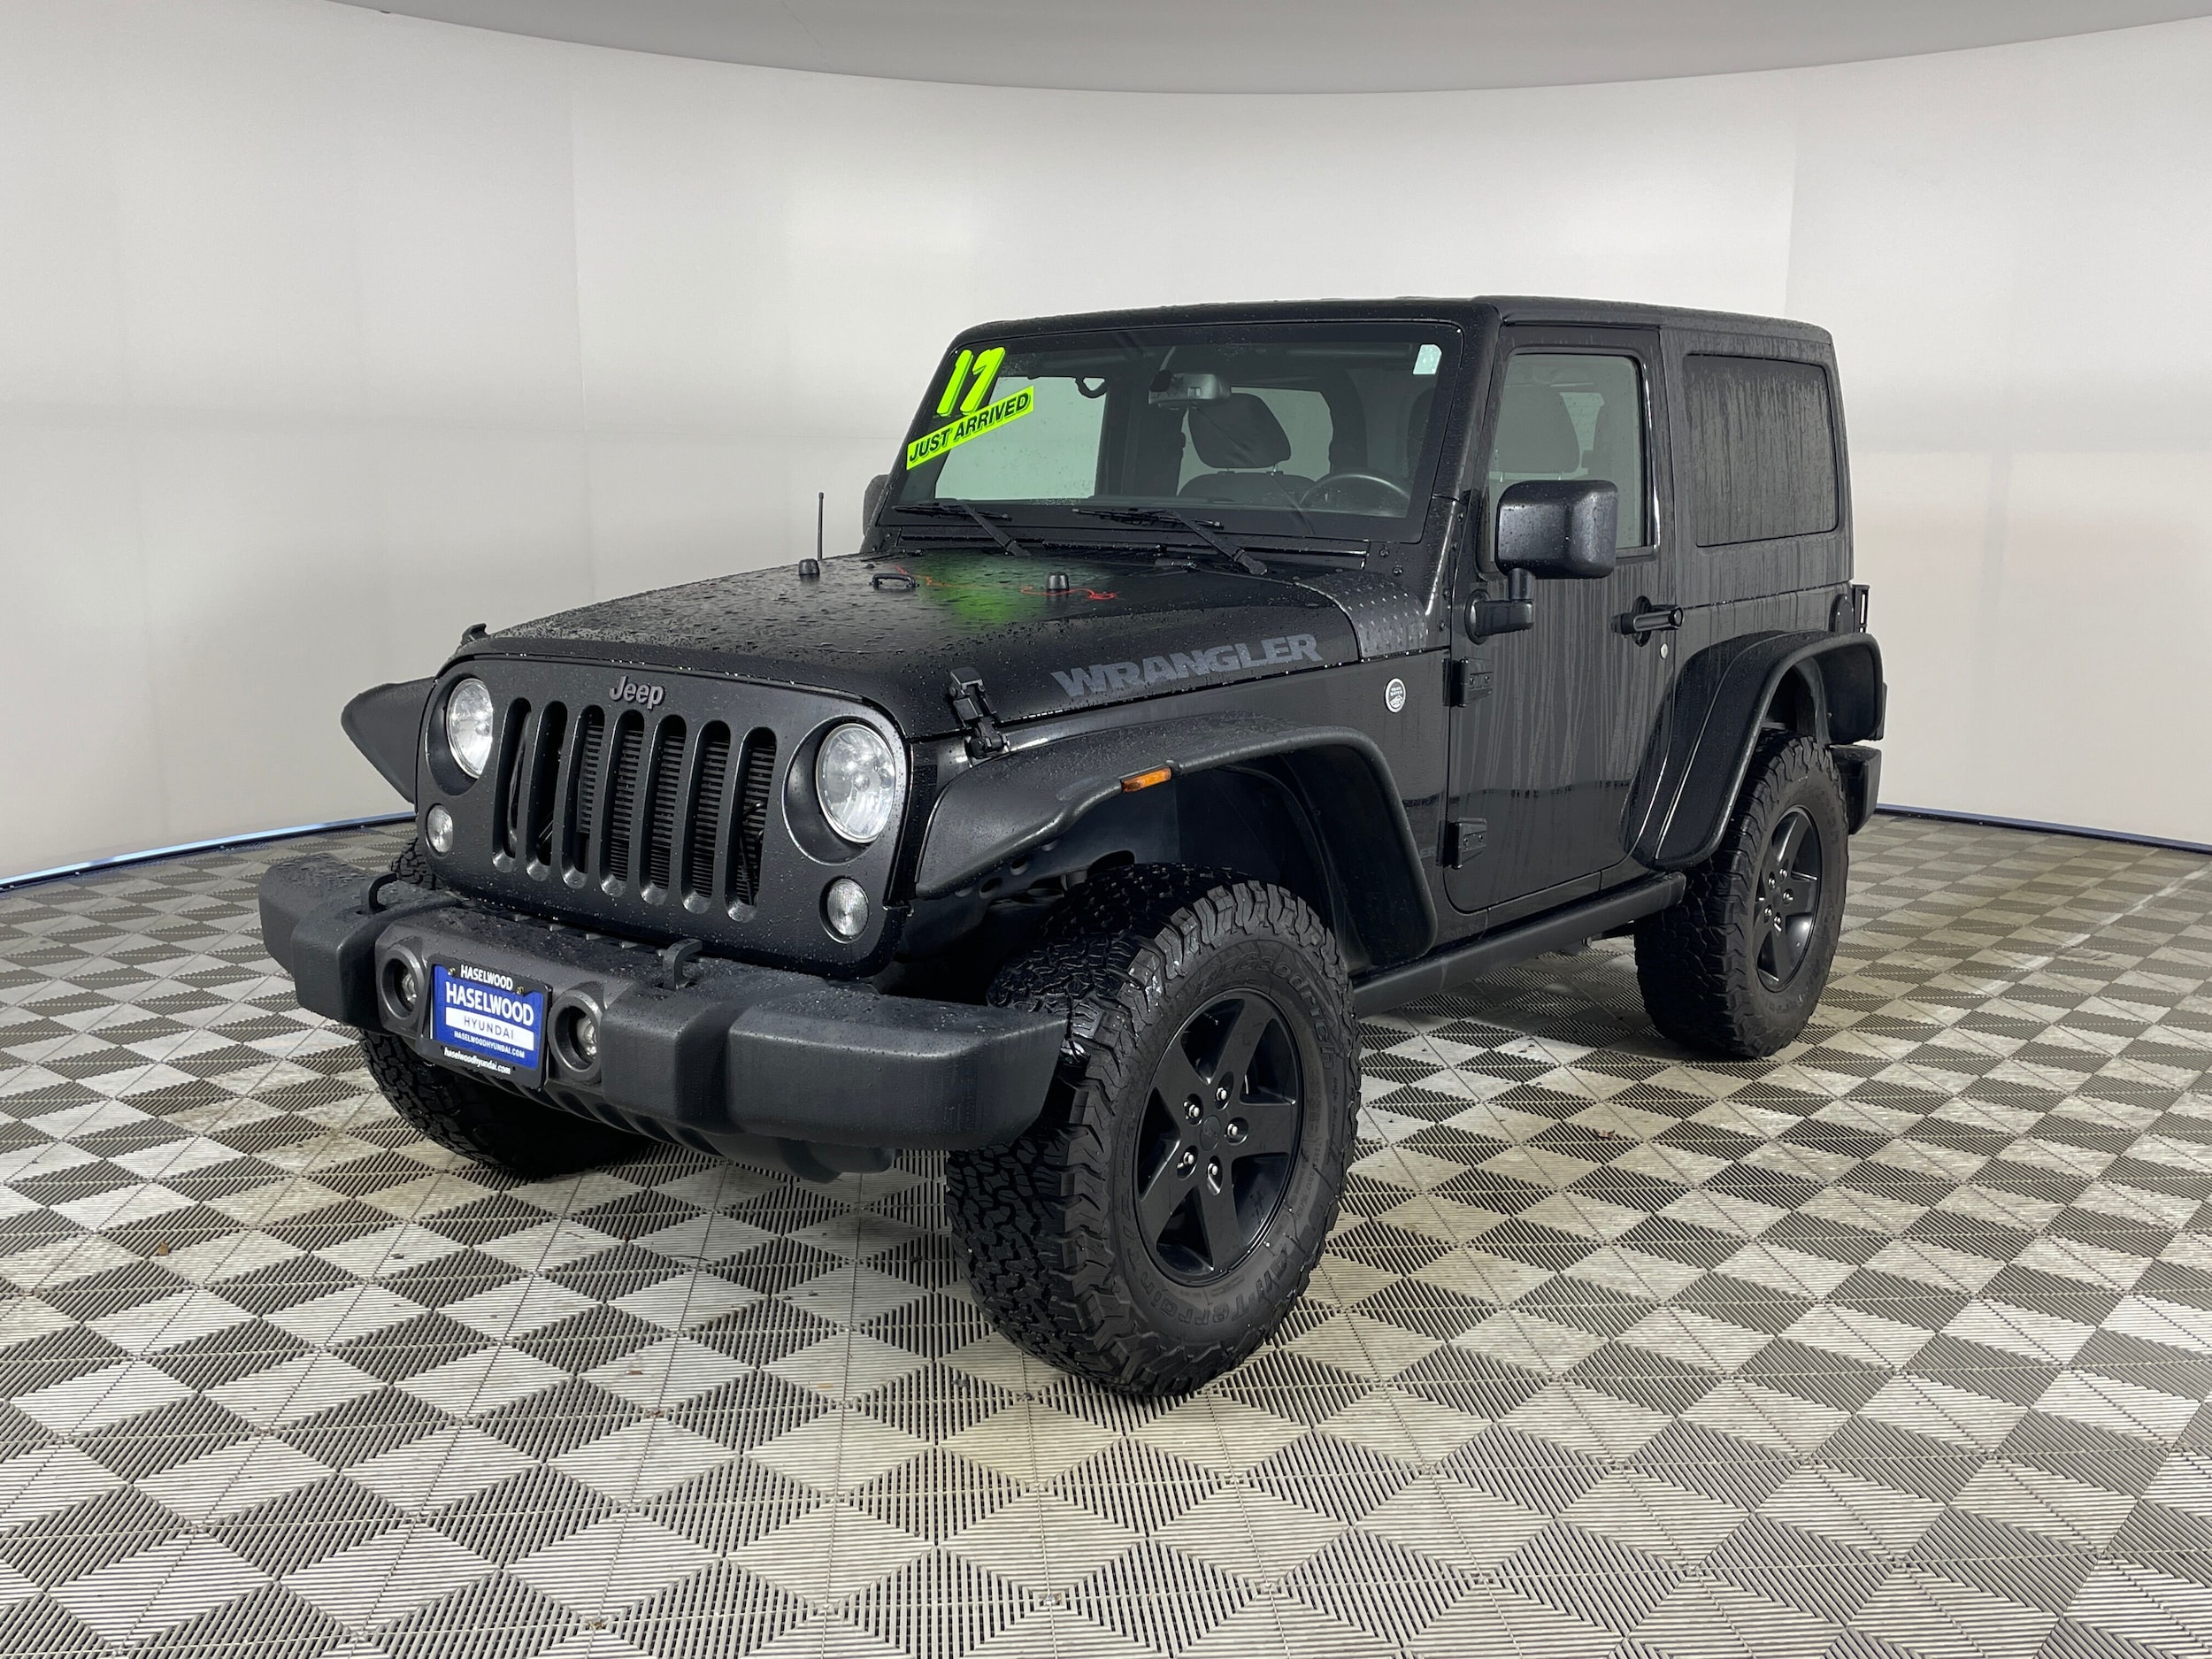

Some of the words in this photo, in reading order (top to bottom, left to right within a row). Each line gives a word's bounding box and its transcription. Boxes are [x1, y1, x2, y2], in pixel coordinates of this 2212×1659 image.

[936, 346, 1006, 417] 17
[909, 429, 952, 463] JUST
[954, 392, 1032, 442] ARRIVED
[1050, 633, 1324, 698] WRANGLER
[609, 675, 665, 710] Jeep
[460, 964, 513, 991] HASELWOOD
[445, 981, 534, 1026] HASELWOOD
[454, 1031, 526, 1058] HASELWOODHYUNDAI.COM
[464, 1015, 514, 1040] HYUNDAI
[443, 1047, 511, 1075] haselwoodhyundai.com
